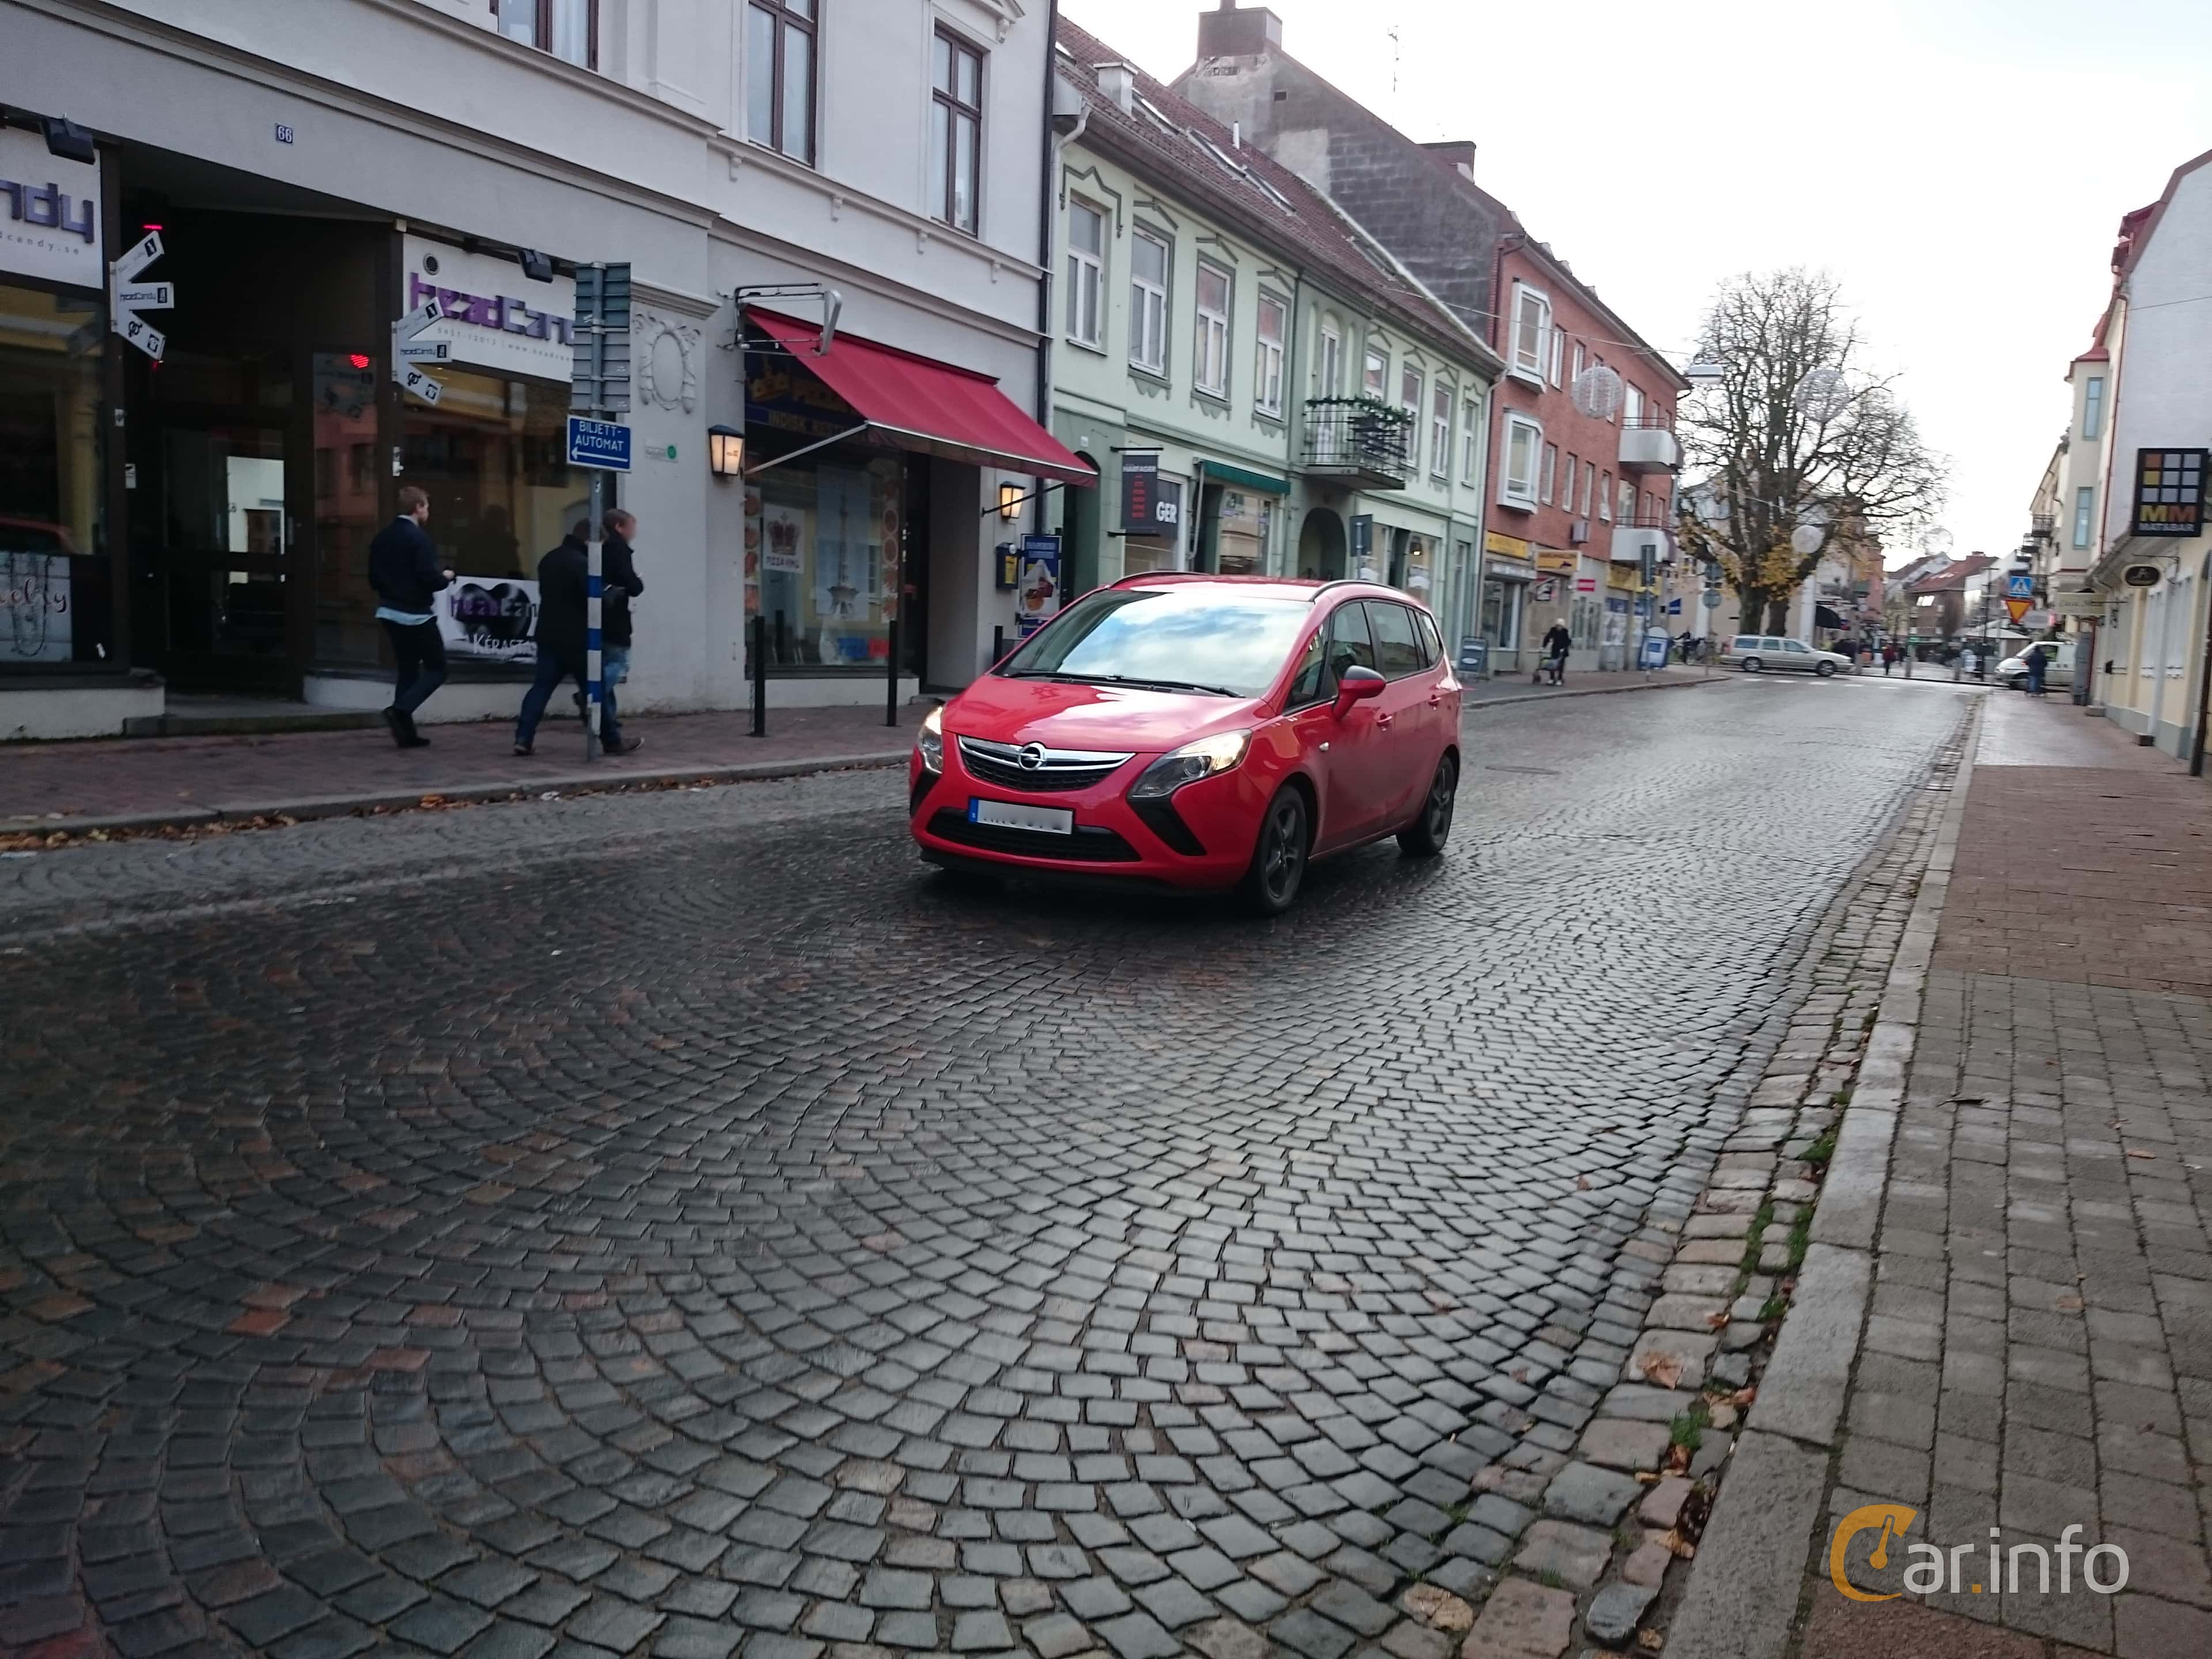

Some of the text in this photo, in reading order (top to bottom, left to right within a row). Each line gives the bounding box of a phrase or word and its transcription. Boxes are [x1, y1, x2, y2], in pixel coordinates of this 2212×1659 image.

[278, 126, 292, 142] 66
[0, 231, 79, 255] candy.se
[507, 344, 570, 361] www.headcan
[579, 421, 622, 437] BILJETT-
[575, 434, 624, 452] AUTOMAT
[1156, 501, 1177, 524] GER
[2139, 505, 2196, 522] MM
